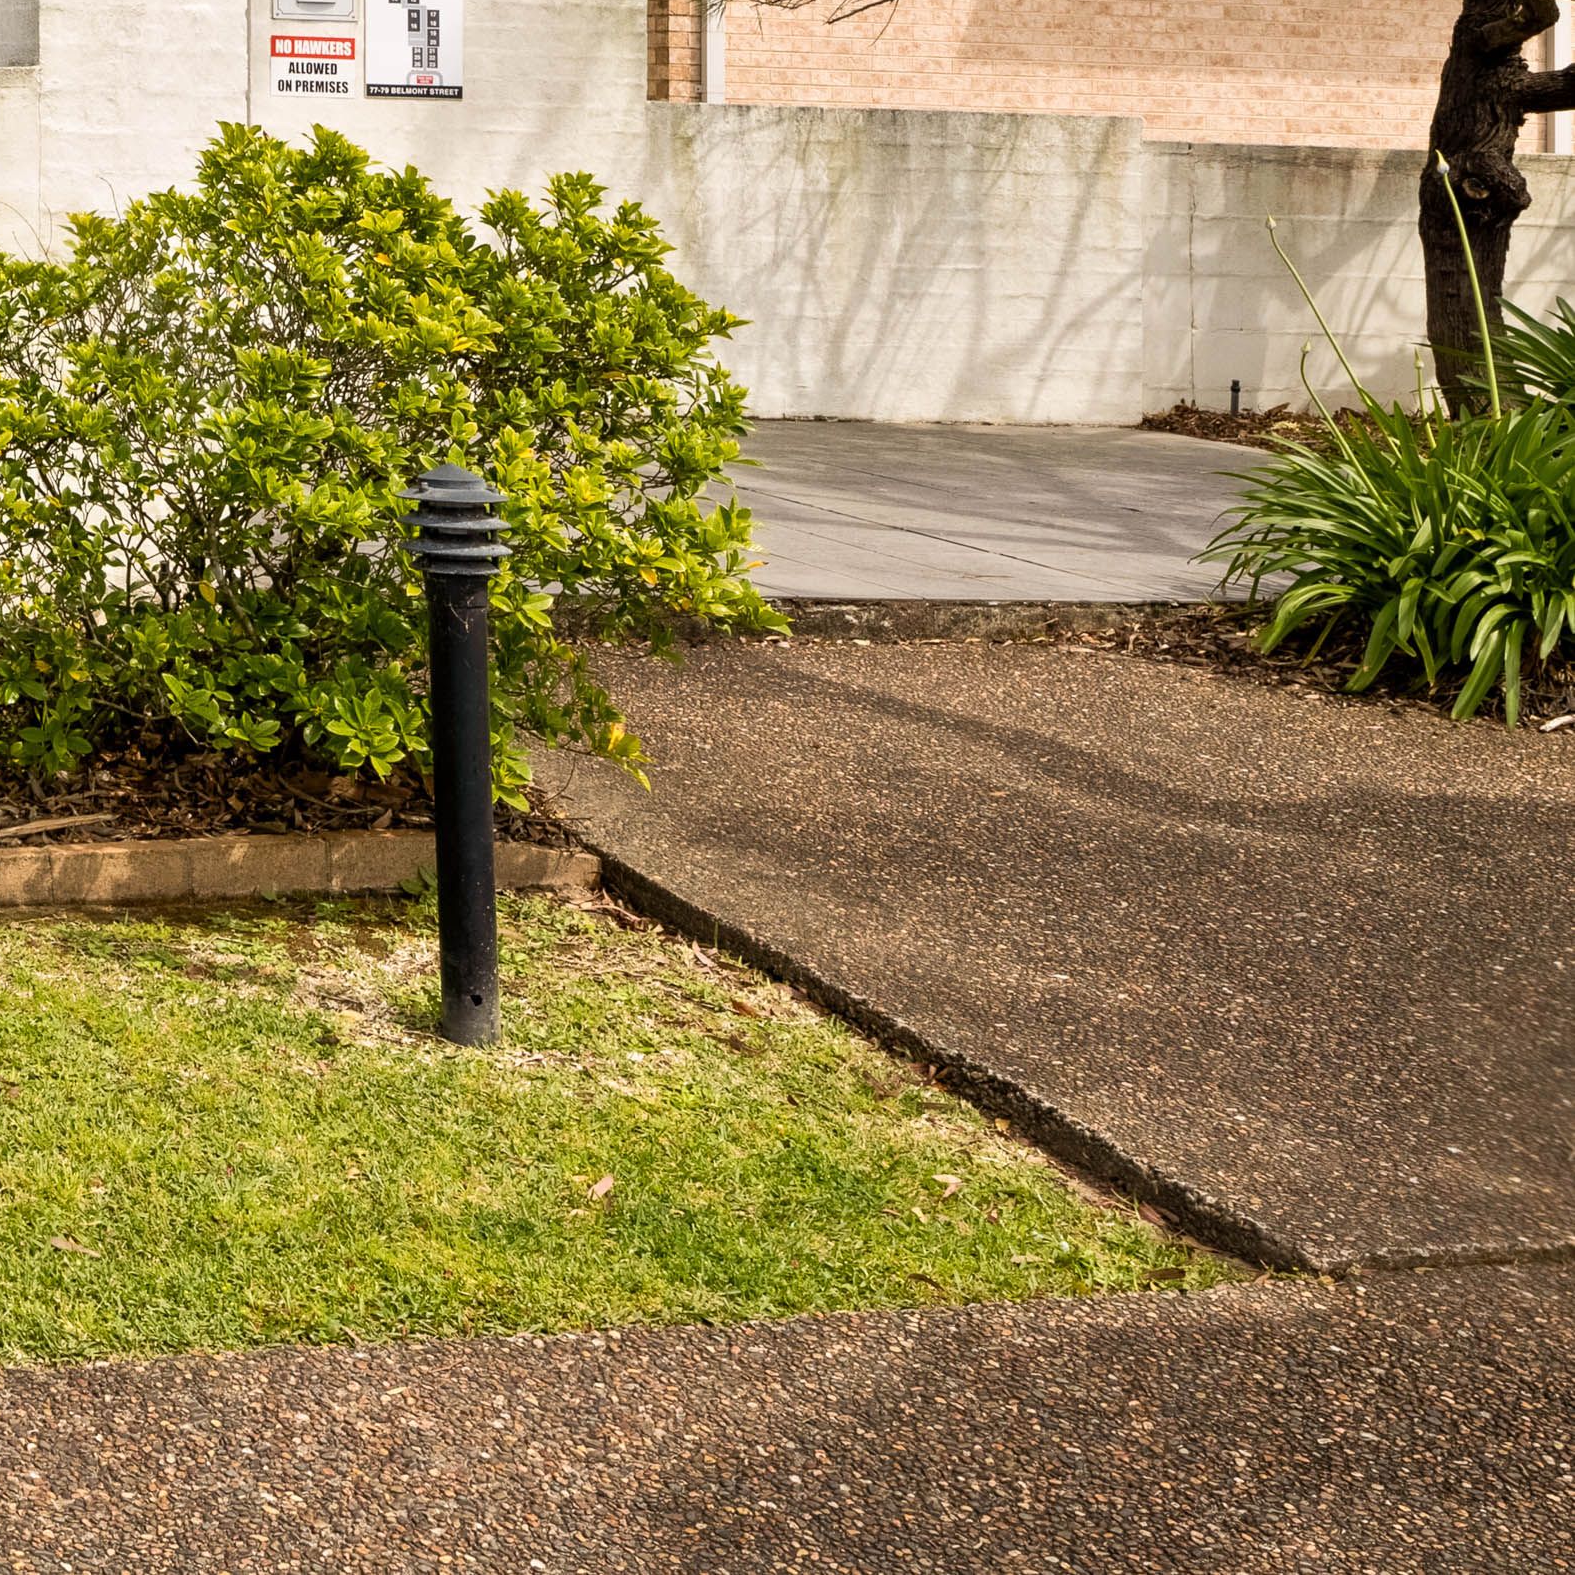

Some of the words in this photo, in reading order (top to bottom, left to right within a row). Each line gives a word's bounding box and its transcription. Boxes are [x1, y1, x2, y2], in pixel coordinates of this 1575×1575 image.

[275, 39, 292, 54] NO
[294, 39, 352, 57] HAWKERS
[288, 61, 338, 75] ALLOWED
[277, 79, 292, 92] ON
[295, 79, 349, 94] PREMISES
[369, 86, 389, 94] 77-79
[391, 86, 428, 95] BELMONT
[429, 88, 459, 96] STREET
